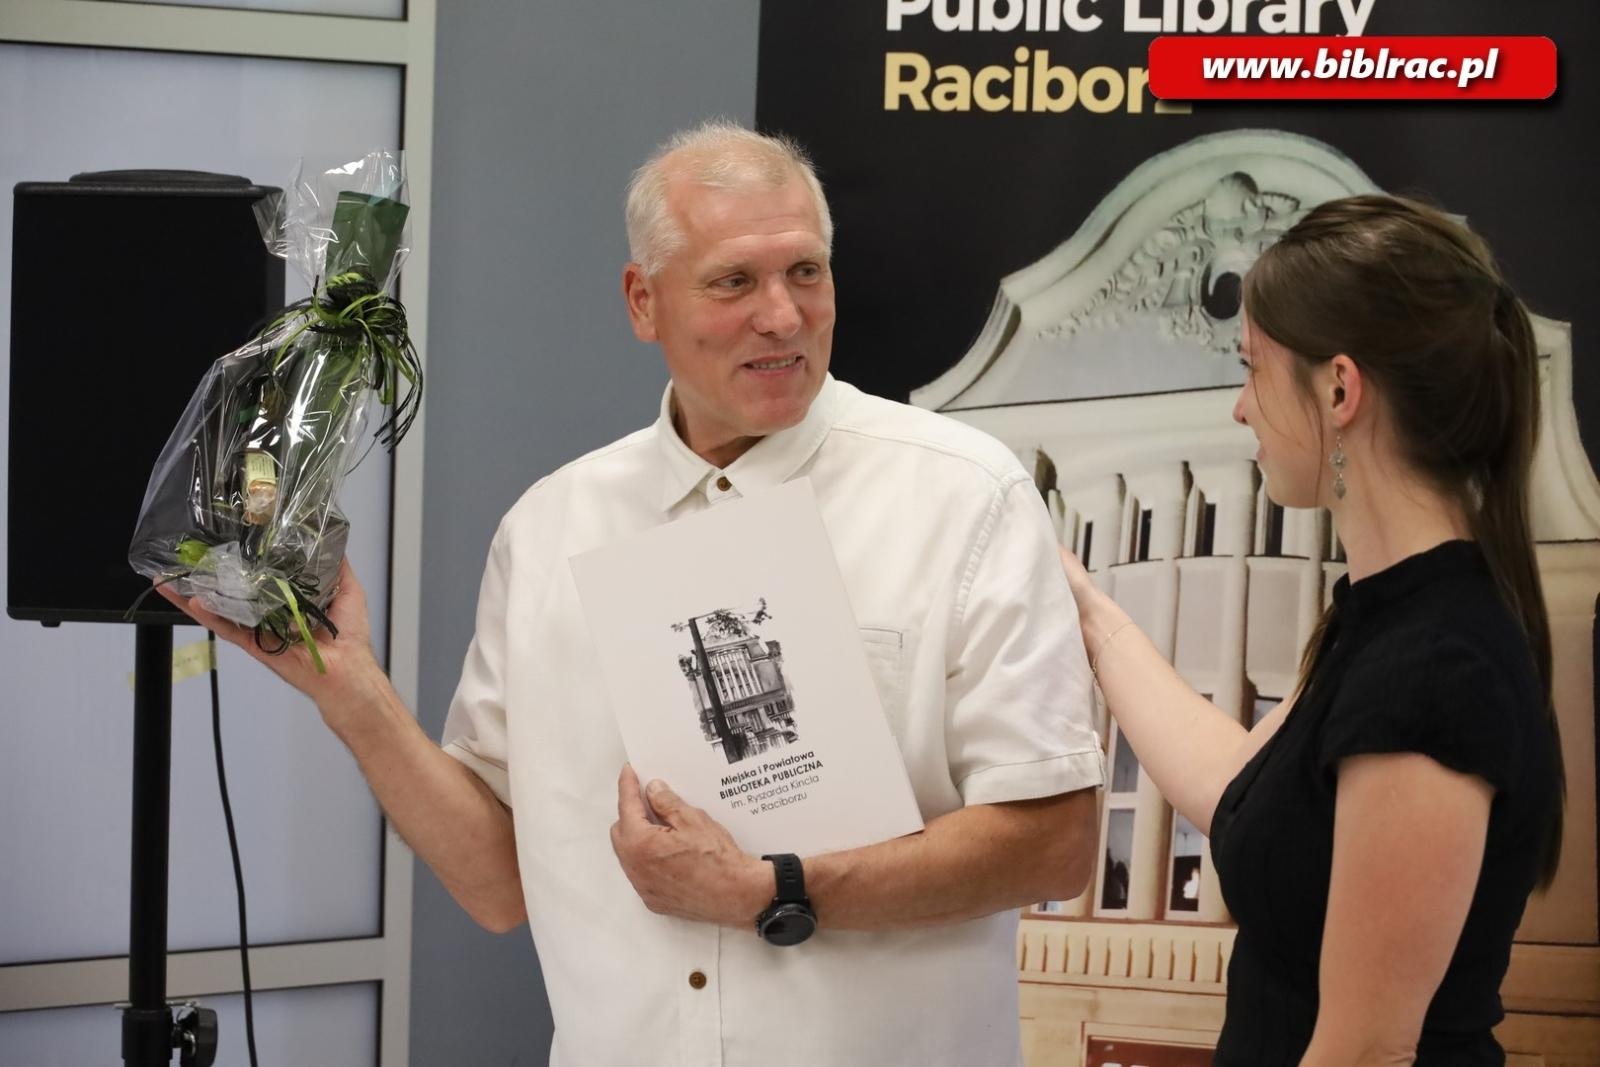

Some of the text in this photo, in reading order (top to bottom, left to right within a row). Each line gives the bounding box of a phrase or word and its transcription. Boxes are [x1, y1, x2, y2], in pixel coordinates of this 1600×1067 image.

[886, 0, 1374, 37] Public Library
[884, 46, 1193, 114] Racibor
[720, 760, 823, 800] BIBLIOTEKA PUBLICZNA
[721, 768, 757, 787] Miejska
[763, 751, 815, 773] Powiatowa
[731, 774, 820, 809] im. Ryszarda Kincla
[750, 791, 808, 816] w Raciborzu
